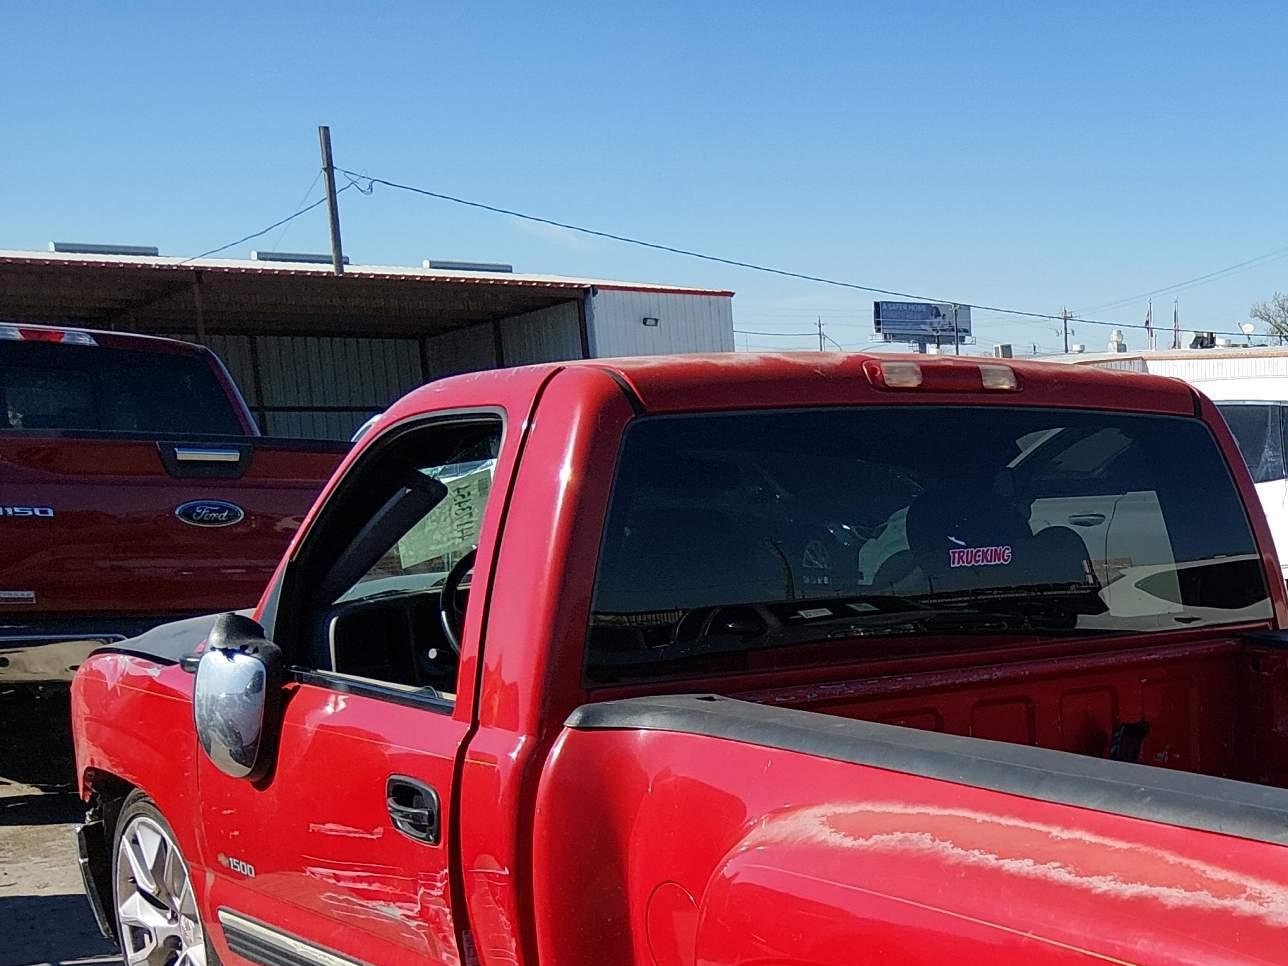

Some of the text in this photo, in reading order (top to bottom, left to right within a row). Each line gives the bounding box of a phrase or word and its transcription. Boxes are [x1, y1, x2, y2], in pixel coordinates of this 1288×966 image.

[0, 507, 54, 517] 150
[193, 506, 229, 520] Ford
[949, 546, 1012, 567] TRUCKING
[229, 857, 255, 878] 1500
